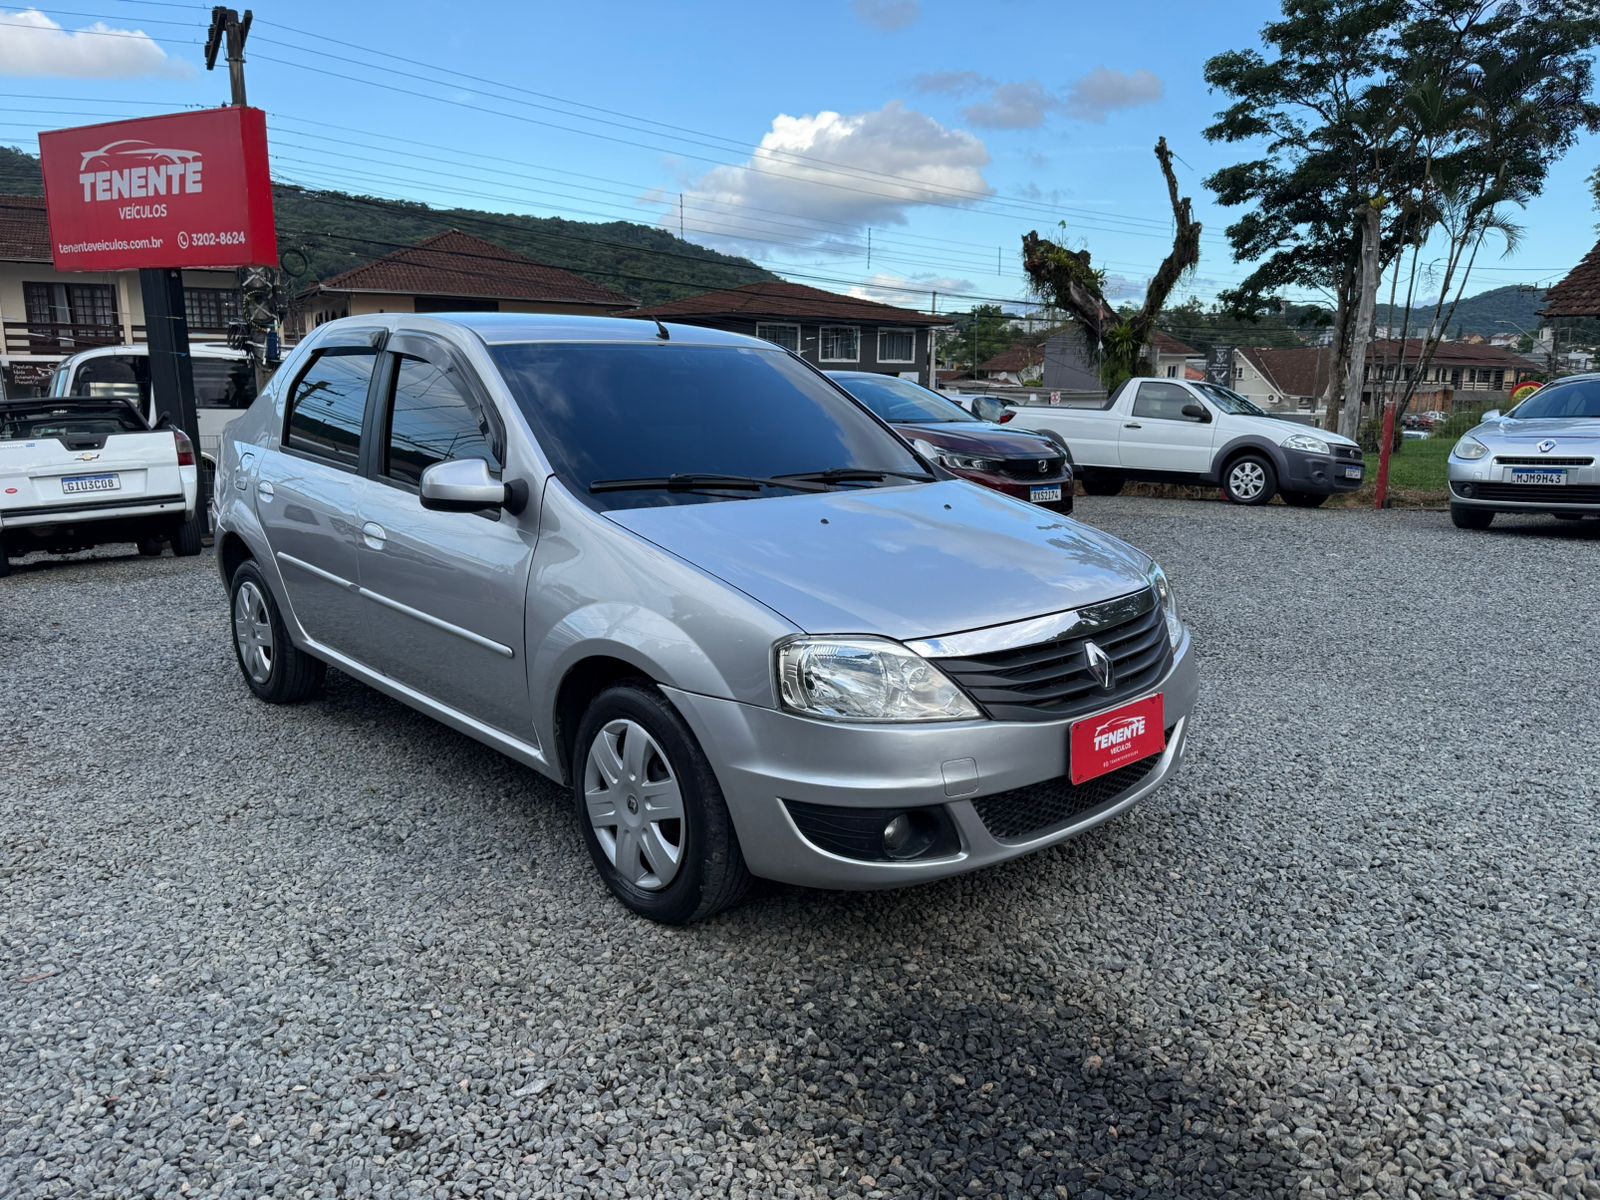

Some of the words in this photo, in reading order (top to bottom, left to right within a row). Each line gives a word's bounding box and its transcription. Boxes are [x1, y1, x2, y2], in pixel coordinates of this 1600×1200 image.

[79, 161, 203, 202] TENENTE
[119, 203, 168, 220] VEÍCULOS
[58, 236, 163, 254] tenenteveiculos.com.br
[191, 231, 246, 247] 3202-8624
[1516, 473, 1561, 484] MJM9H43
[1094, 720, 1146, 751] TENENTE
